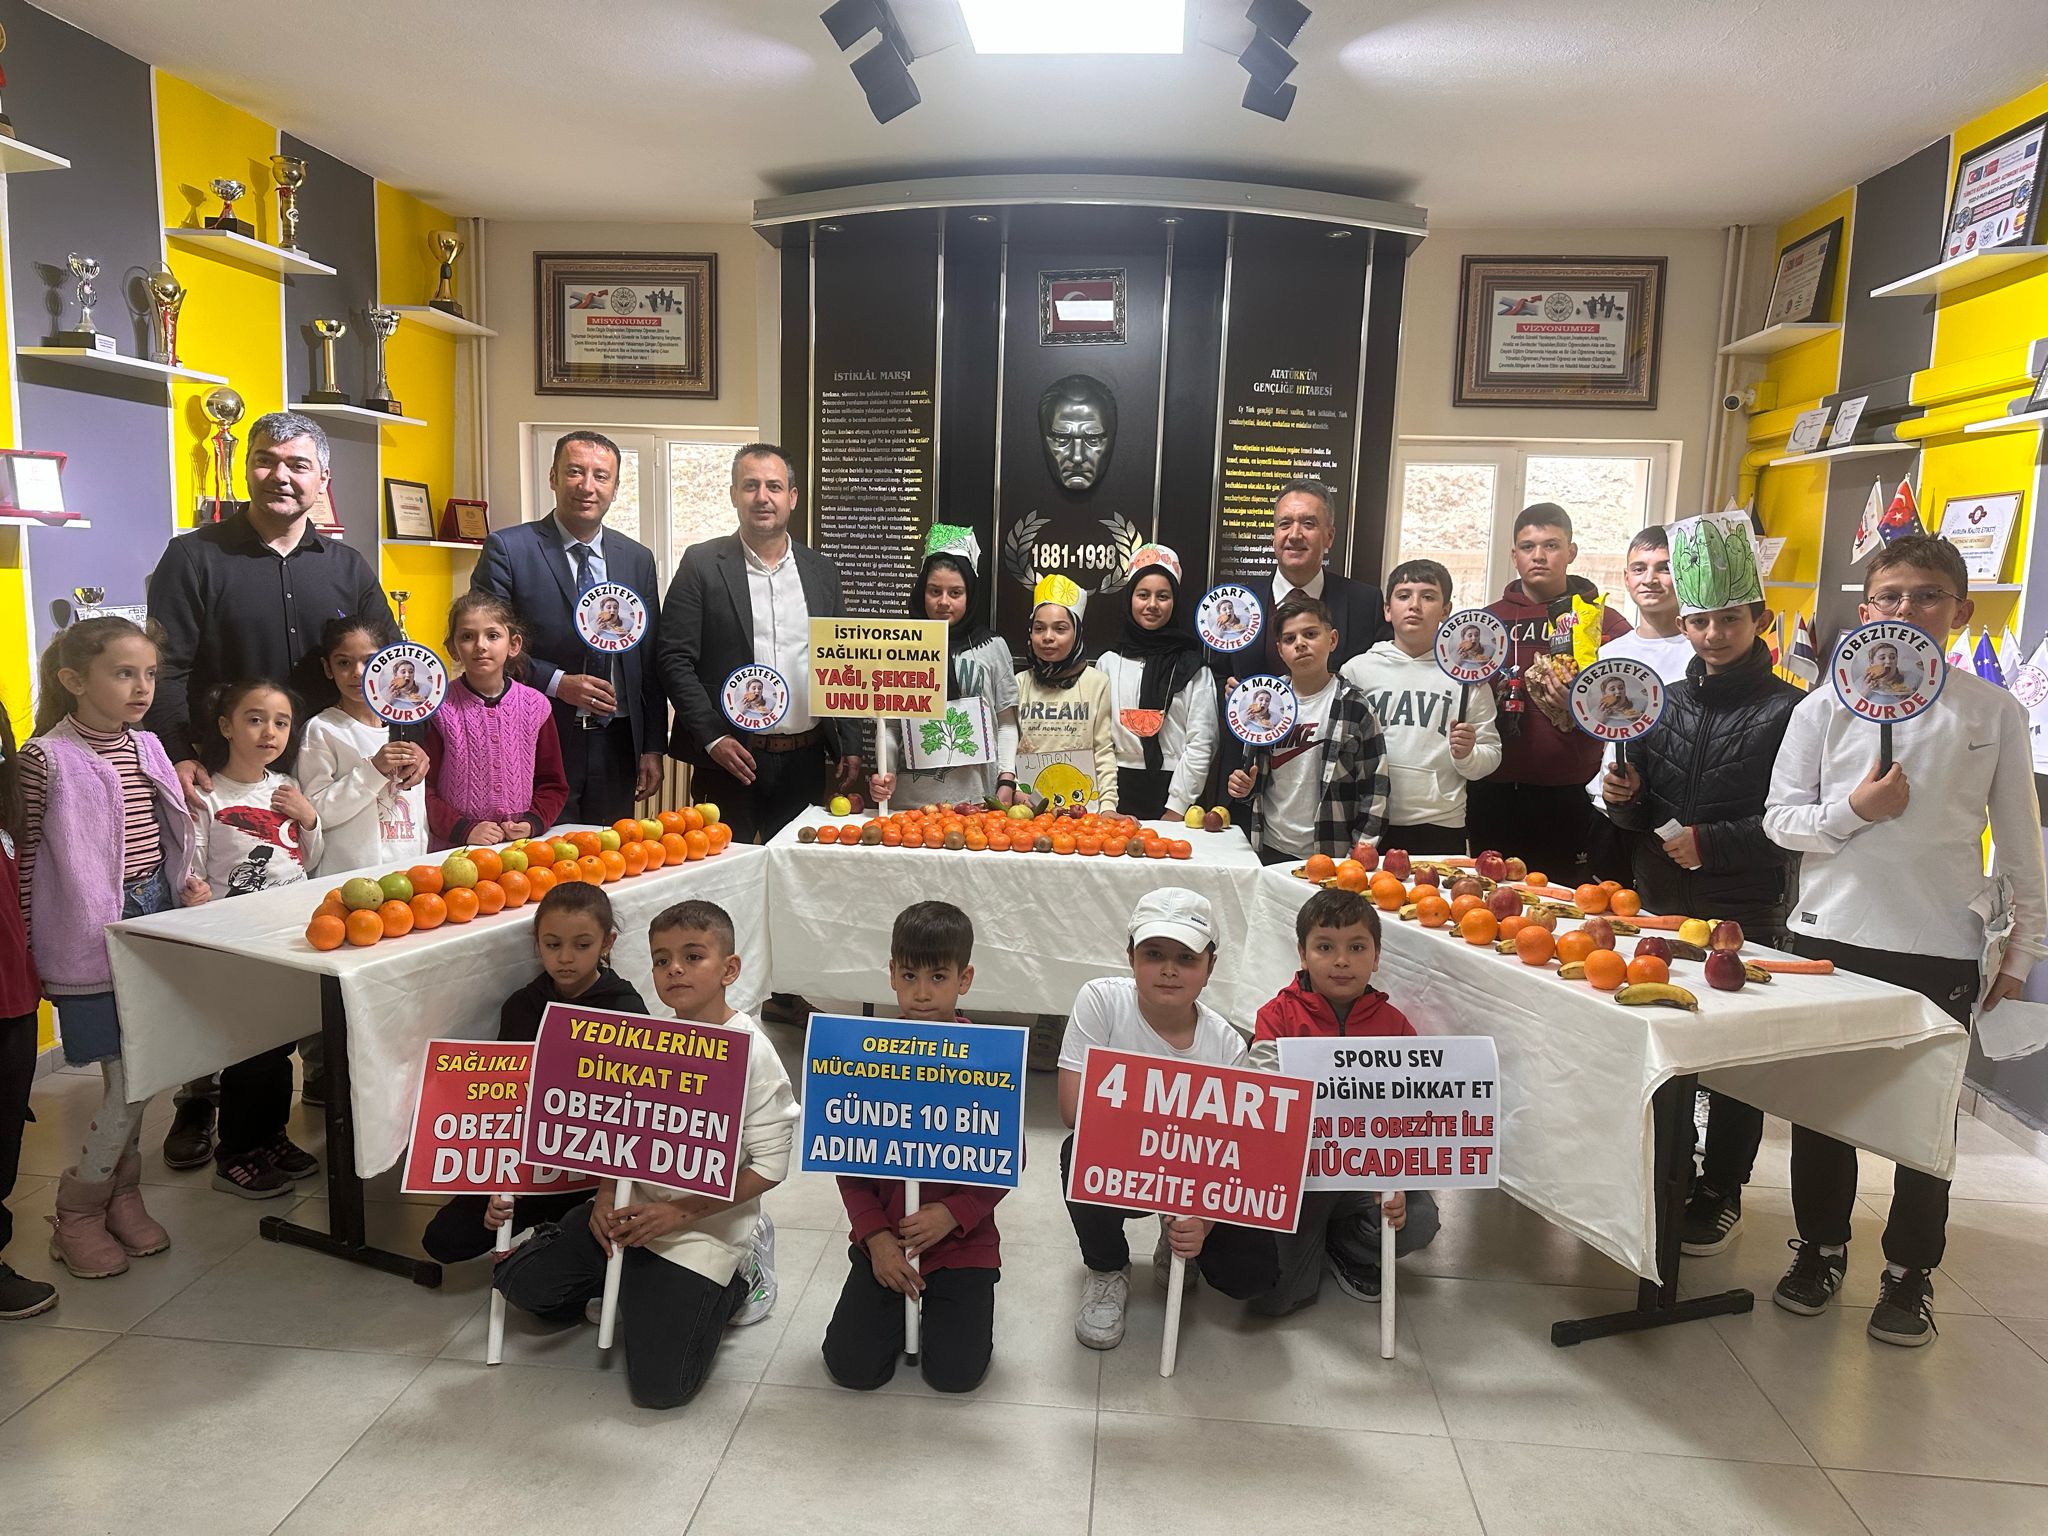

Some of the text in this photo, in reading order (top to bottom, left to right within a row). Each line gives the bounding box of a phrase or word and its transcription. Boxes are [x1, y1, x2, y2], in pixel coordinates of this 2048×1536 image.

[592, 318, 658, 326] MİSYONUMUZ
[1522, 324, 1595, 332] VİZYONUMUZ
[834, 370, 911, 381] İSTİKLÂL MARŞI
[1270, 368, 1317, 381] ATATÜRK'ÜN
[1253, 382, 1294, 396] GENÇLİĞE
[1032, 543, 1116, 570] 1881-1938
[582, 583, 638, 607] OBEZİTEYE
[1202, 588, 1246, 611] 4 MART
[835, 624, 922, 641] İSTİYORSAN
[1202, 613, 1260, 649] OBEZİTE GÜNÜ
[1442, 612, 1500, 638] OBEZİTEYE
[590, 634, 636, 650] DUR DE
[817, 644, 940, 661] SAĞLIKLI OLMAK
[1841, 624, 1929, 661] OBEZİTEYE
[371, 645, 436, 673] OBEZİTEYE
[1451, 661, 1498, 680] DUR DE
[729, 667, 780, 688] OBEZİTEYE
[815, 665, 940, 692] YAĞI, ŞEKERİ,
[1241, 678, 1289, 696] 4 MART
[1577, 661, 1649, 694] OBEZİTEYE
[380, 700, 435, 721] DUR DE
[825, 692, 932, 712] UNU BIRAK
[1021, 701, 1090, 720] DREAM
[1366, 690, 1453, 737] MAVİ
[1854, 693, 1928, 719] DUR DE
[735, 713, 778, 728] DUR DE
[1064, 725, 1078, 734] stop
[1229, 710, 1292, 742] OBEZİTE GÜNÜ
[1593, 714, 1654, 738] DUR DE
[380, 821, 415, 839] WER
[570, 1019, 729, 1062] YEDİKLERİNE
[862, 1036, 969, 1059] OBEZİTE İLE
[436, 1051, 528, 1072] SAĞLIKLI
[1334, 1050, 1444, 1068] SPORU SEV
[577, 1054, 709, 1096] DİKKAT ET
[812, 1056, 1016, 1091] MÜCADELE EDİYORUZ,
[467, 1082, 518, 1100] SPOR
[1096, 1063, 1300, 1134] 4 MART
[1316, 1076, 1493, 1100] DİĞİNE DİKKAT ET
[432, 1106, 525, 1141] OBEZİ
[544, 1087, 730, 1143] OBEZİTEDEN
[825, 1093, 1000, 1136] GÜNDE 10 BİN
[1312, 1110, 1493, 1138] EN DE OBEZİTE İLE
[536, 1122, 727, 1188] UZAK DUR
[809, 1135, 1012, 1175] ADIM ATIYORUZ
[1139, 1124, 1241, 1171] DÜNYA
[431, 1147, 522, 1185] DUR
[1460, 1147, 1493, 1176] ET
[1084, 1165, 1288, 1221] OBEZİTE GÜNÜ
